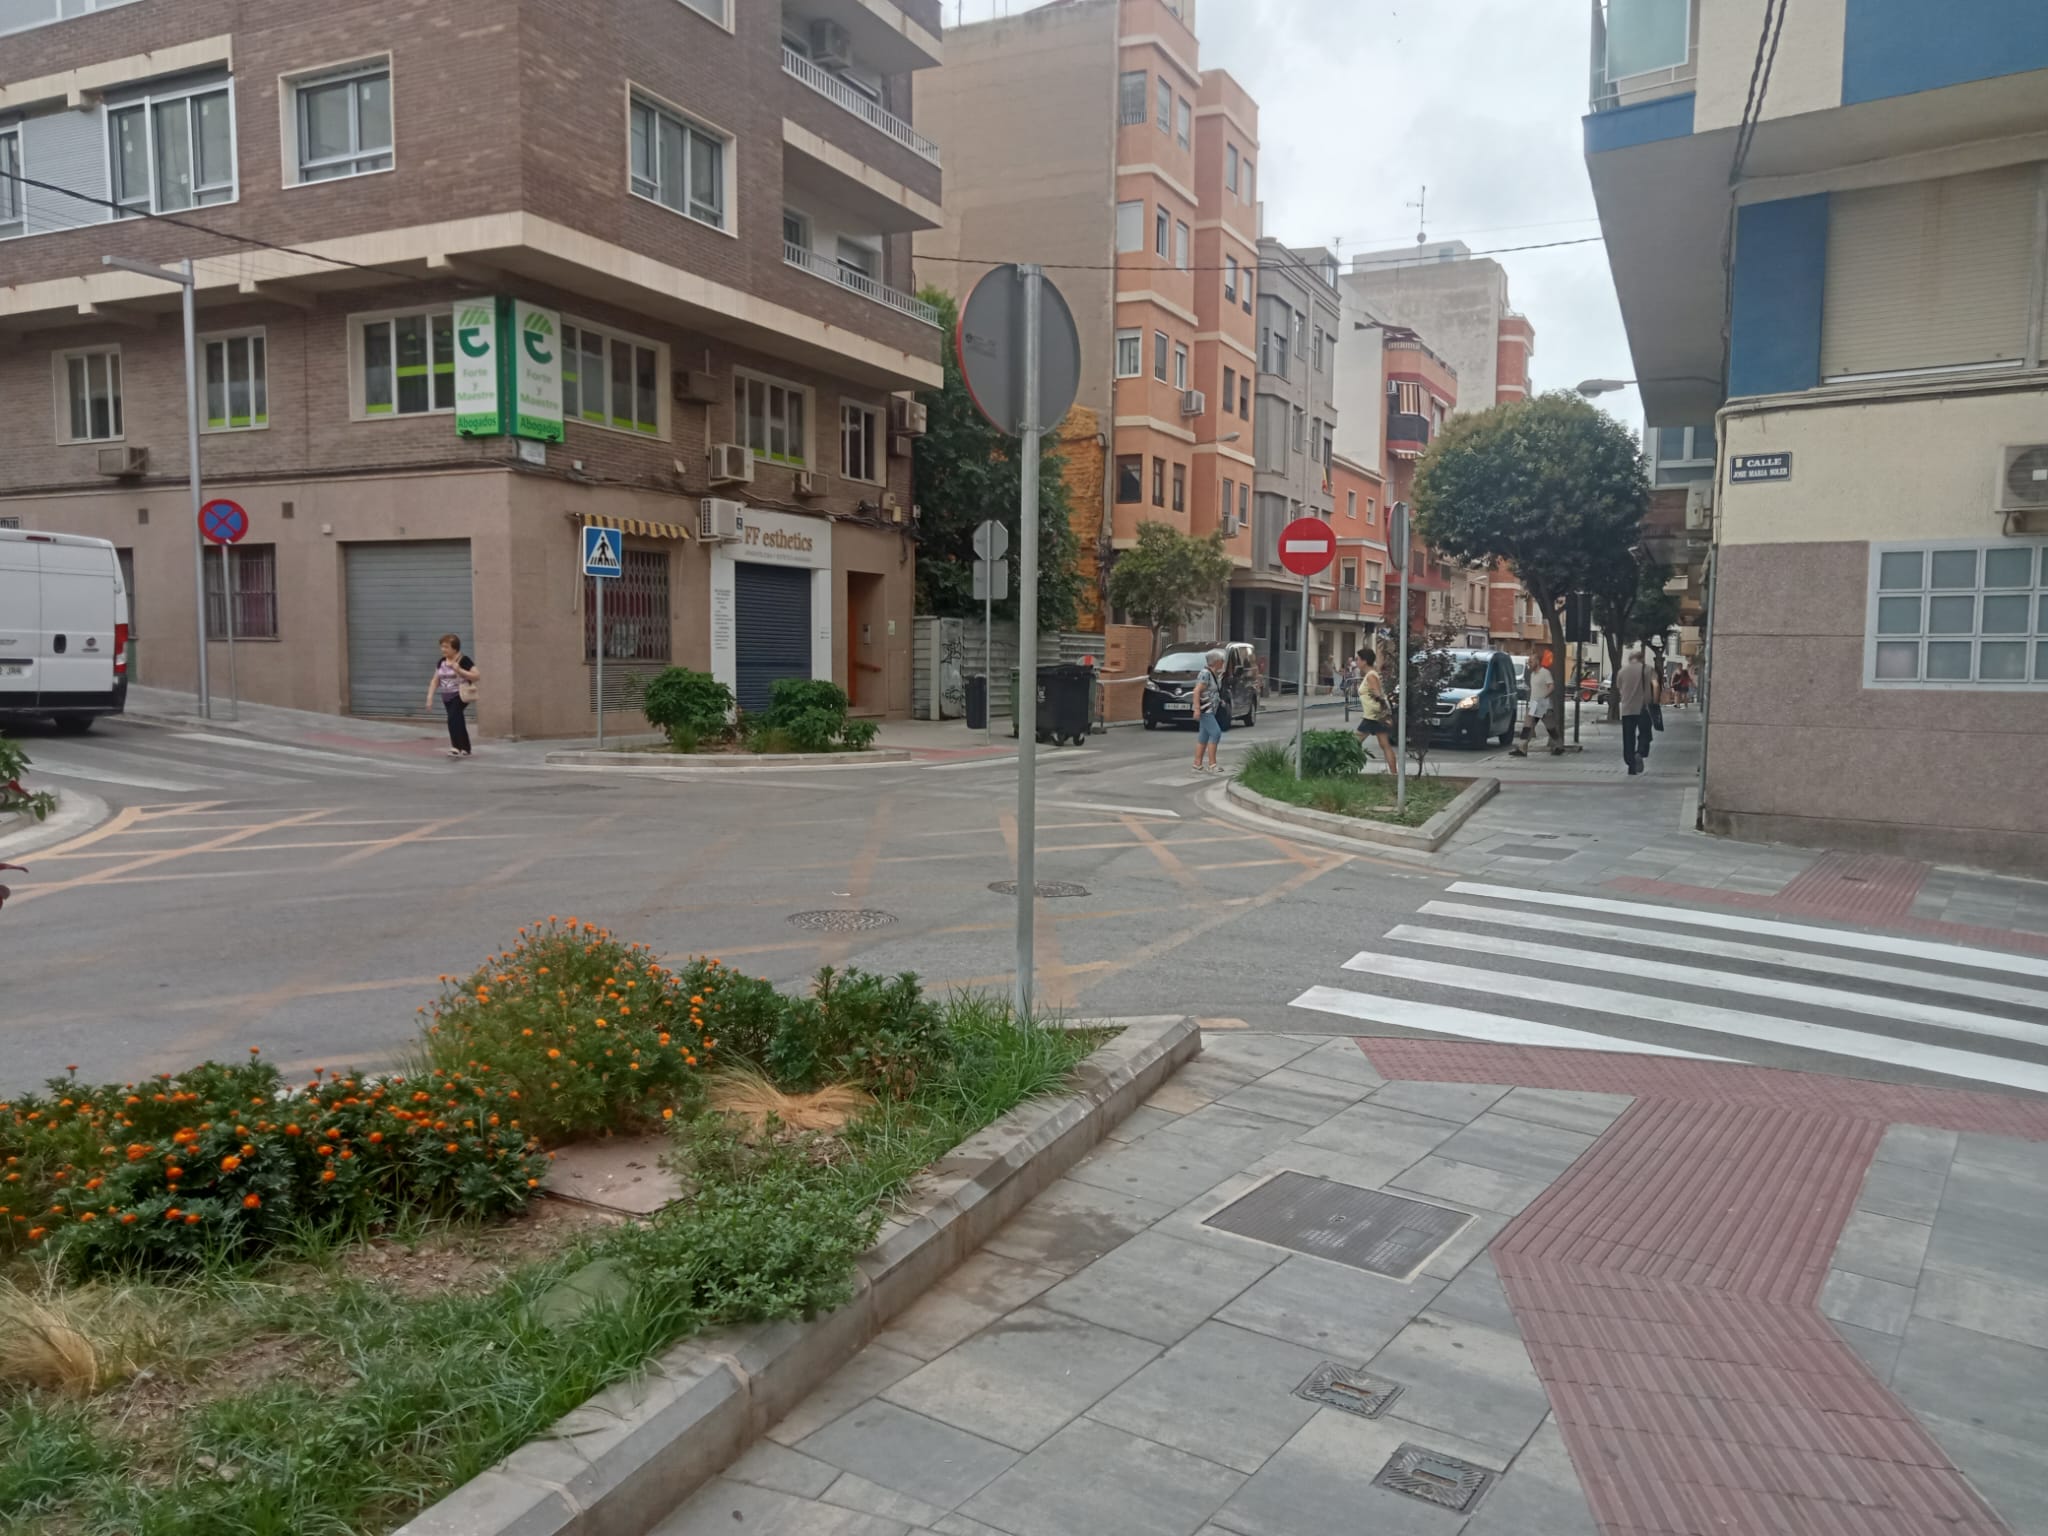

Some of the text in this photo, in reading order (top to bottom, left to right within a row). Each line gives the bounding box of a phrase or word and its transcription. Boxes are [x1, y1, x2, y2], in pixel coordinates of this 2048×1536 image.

[463, 368, 488, 377] Forte
[526, 369, 552, 383] Forte
[457, 391, 495, 401] Maestre
[520, 393, 559, 409] Maestre
[458, 416, 496, 431] Abogados
[520, 418, 560, 436] Abogados
[1747, 458, 1782, 468] CALLE
[1749, 469, 1768, 478] MARIA
[744, 525, 813, 552] FF esthetics
